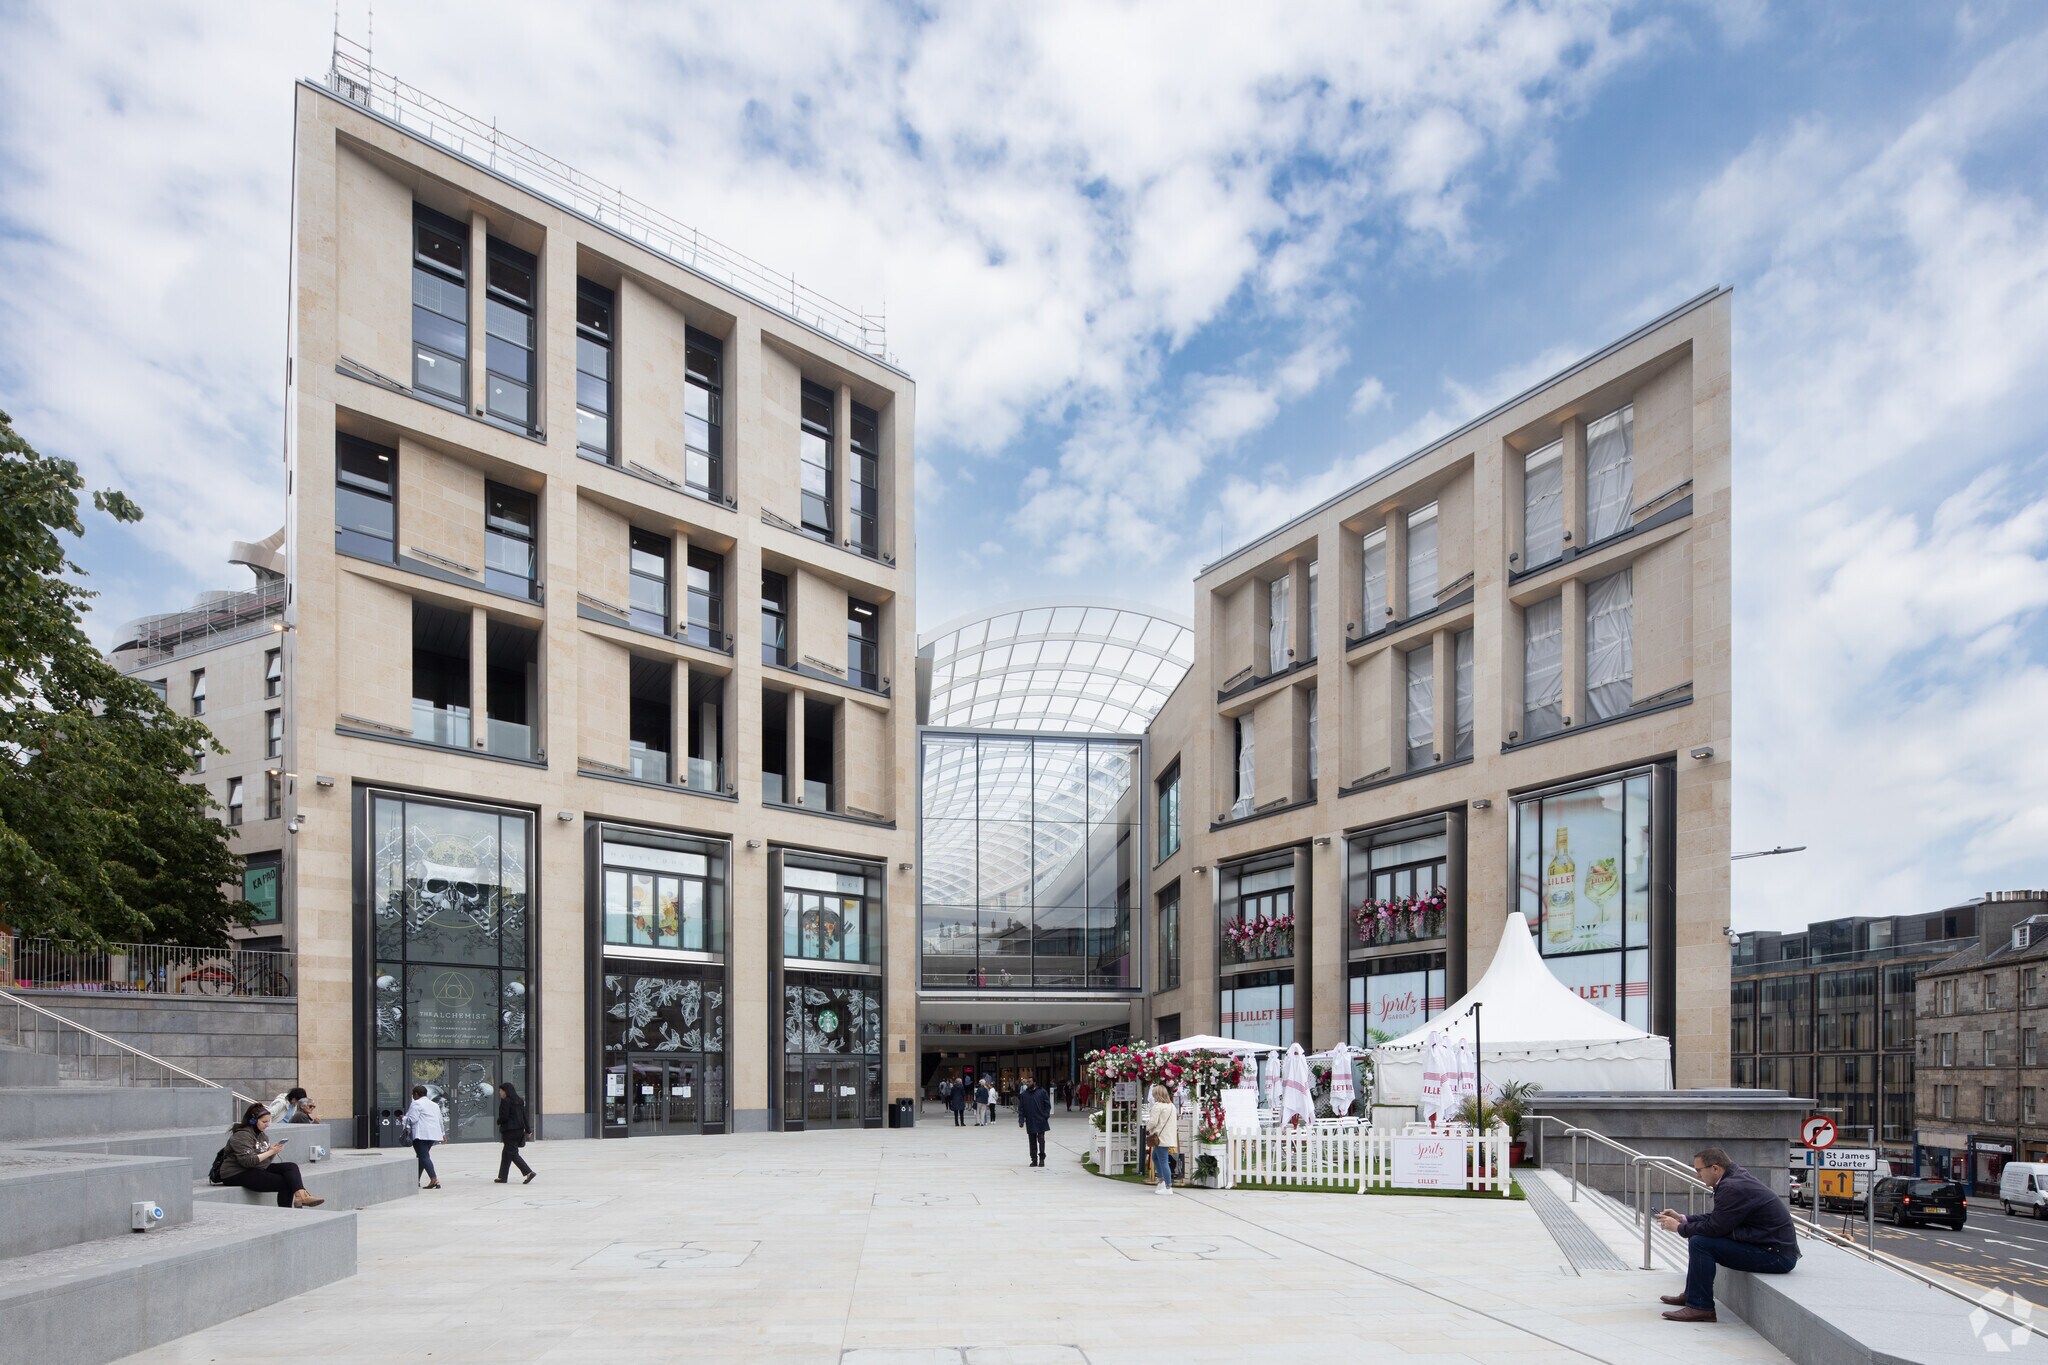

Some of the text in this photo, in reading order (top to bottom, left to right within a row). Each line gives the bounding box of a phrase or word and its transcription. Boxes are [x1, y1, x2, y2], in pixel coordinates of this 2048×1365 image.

[252, 870, 275, 890] KA PAO
[1548, 874, 1575, 886] LILLET
[1570, 985, 1611, 999] LET
[1373, 991, 1418, 1023] Spritz
[433, 1012, 487, 1020] ALCHEMIST
[1240, 1010, 1275, 1022] LILLET
[1412, 1142, 1445, 1160] Spritz
[1826, 1152, 1837, 1160] St
[1840, 1152, 1870, 1160] James
[1829, 1160, 1867, 1168] Quarter
